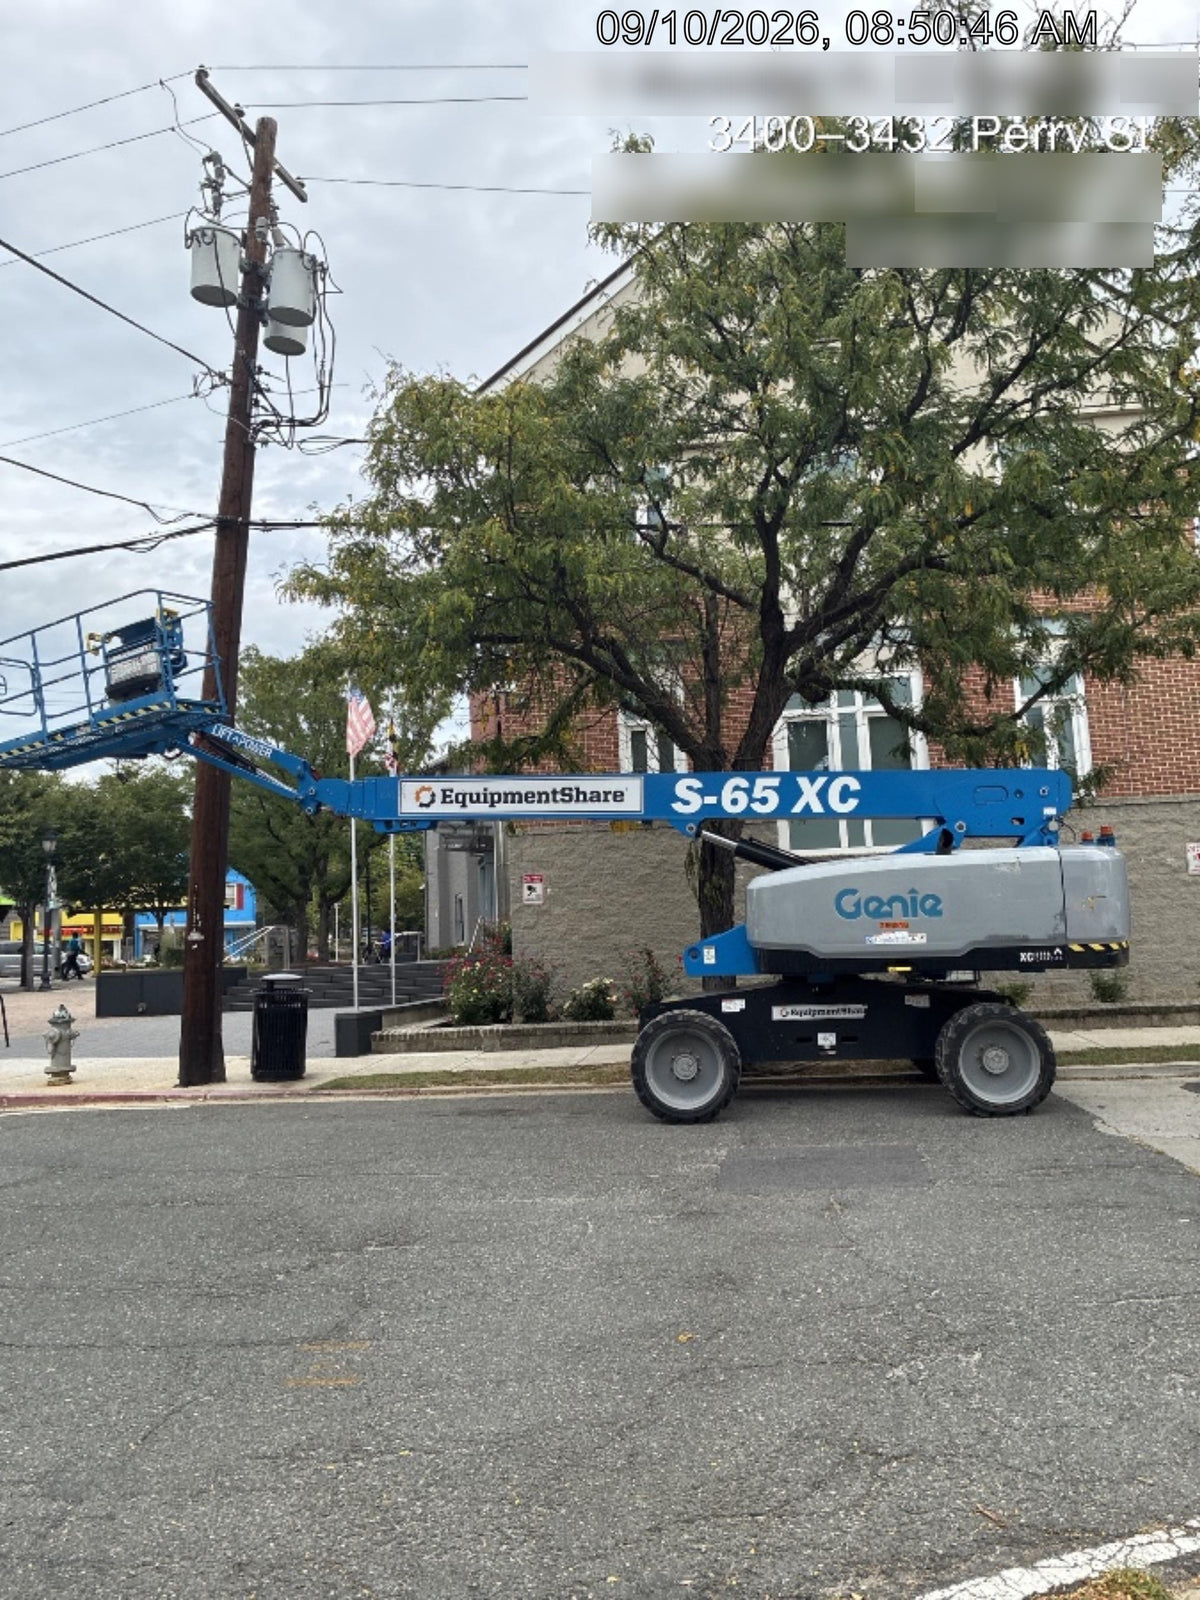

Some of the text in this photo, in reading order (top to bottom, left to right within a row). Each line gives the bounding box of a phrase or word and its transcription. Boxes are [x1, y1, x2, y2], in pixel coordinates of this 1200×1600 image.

[211, 723, 273, 758] LIFT POWER
[440, 786, 625, 808] EquipmentShare
[671, 776, 861, 814] S-65 XC
[835, 887, 943, 919] Genie
